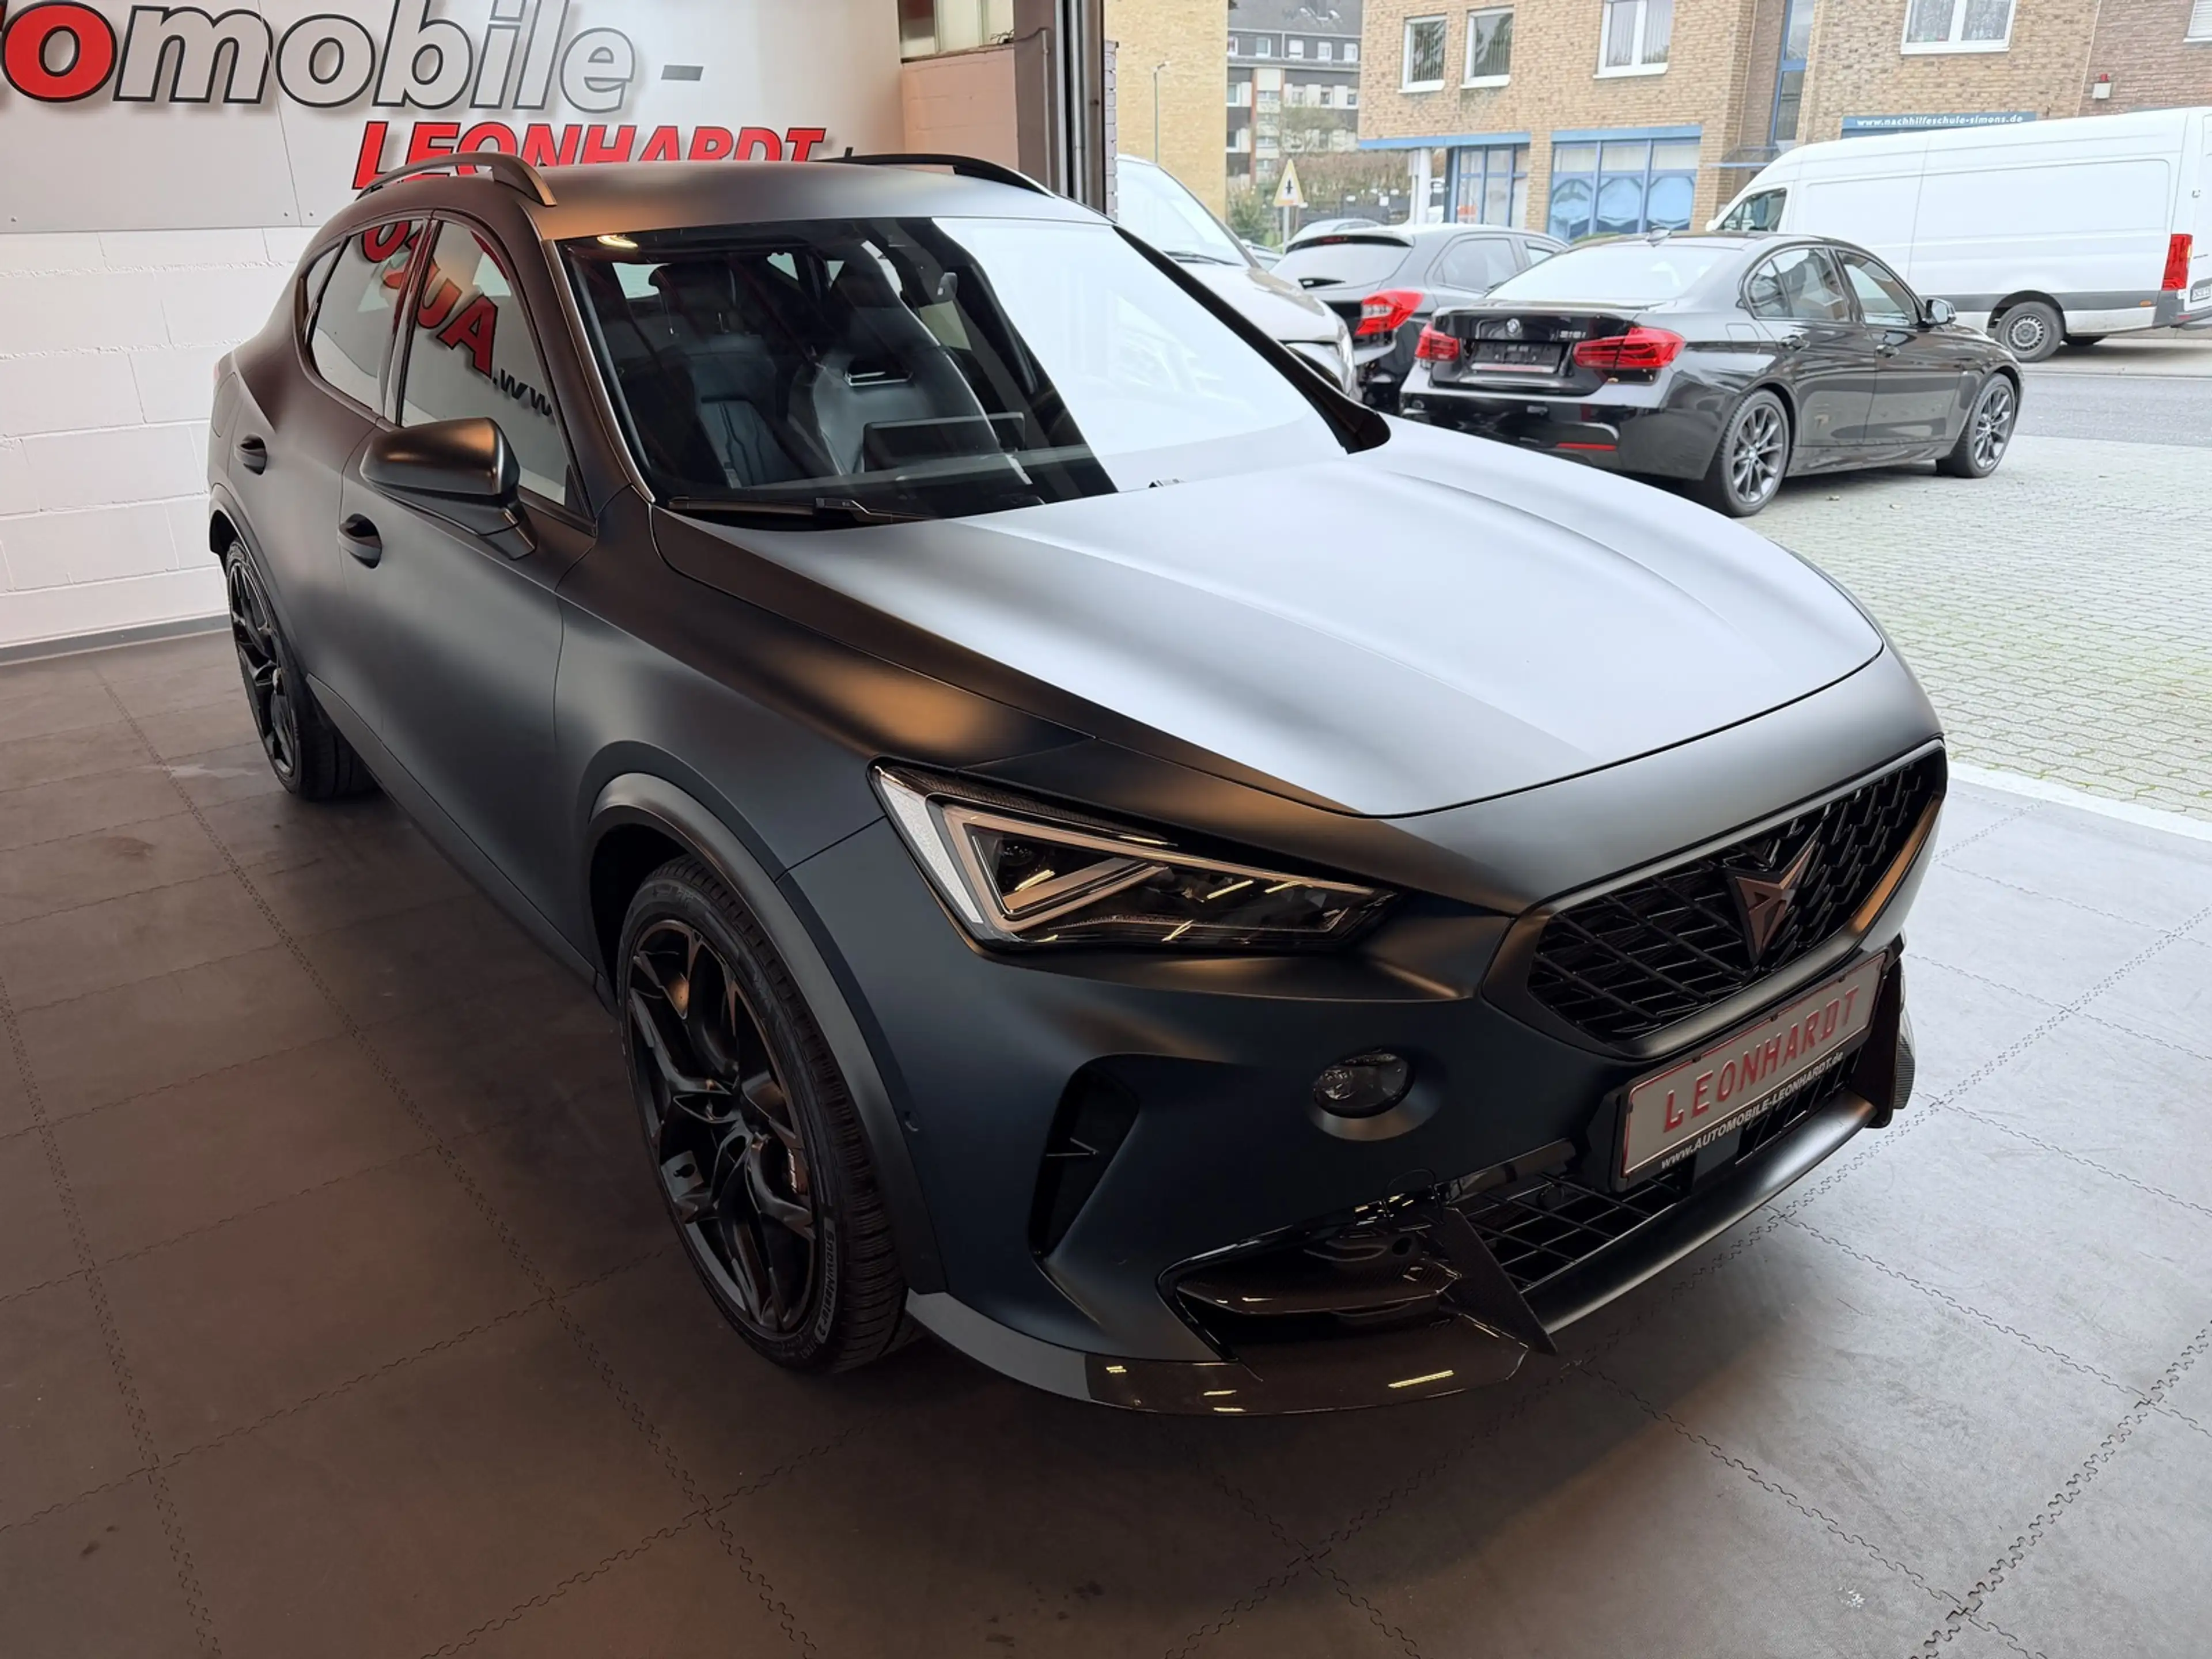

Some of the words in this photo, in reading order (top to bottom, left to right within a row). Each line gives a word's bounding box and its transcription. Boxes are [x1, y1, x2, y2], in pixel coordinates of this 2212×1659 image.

[0, 0, 635, 113] omobile
[1857, 115, 2023, 126] www.nachhilfeschule-simons.de
[1661, 1052, 1844, 1169] www.AUTOMOBILE-LEONHARDT.de
[1664, 986, 1858, 1132] LEONHARDT
